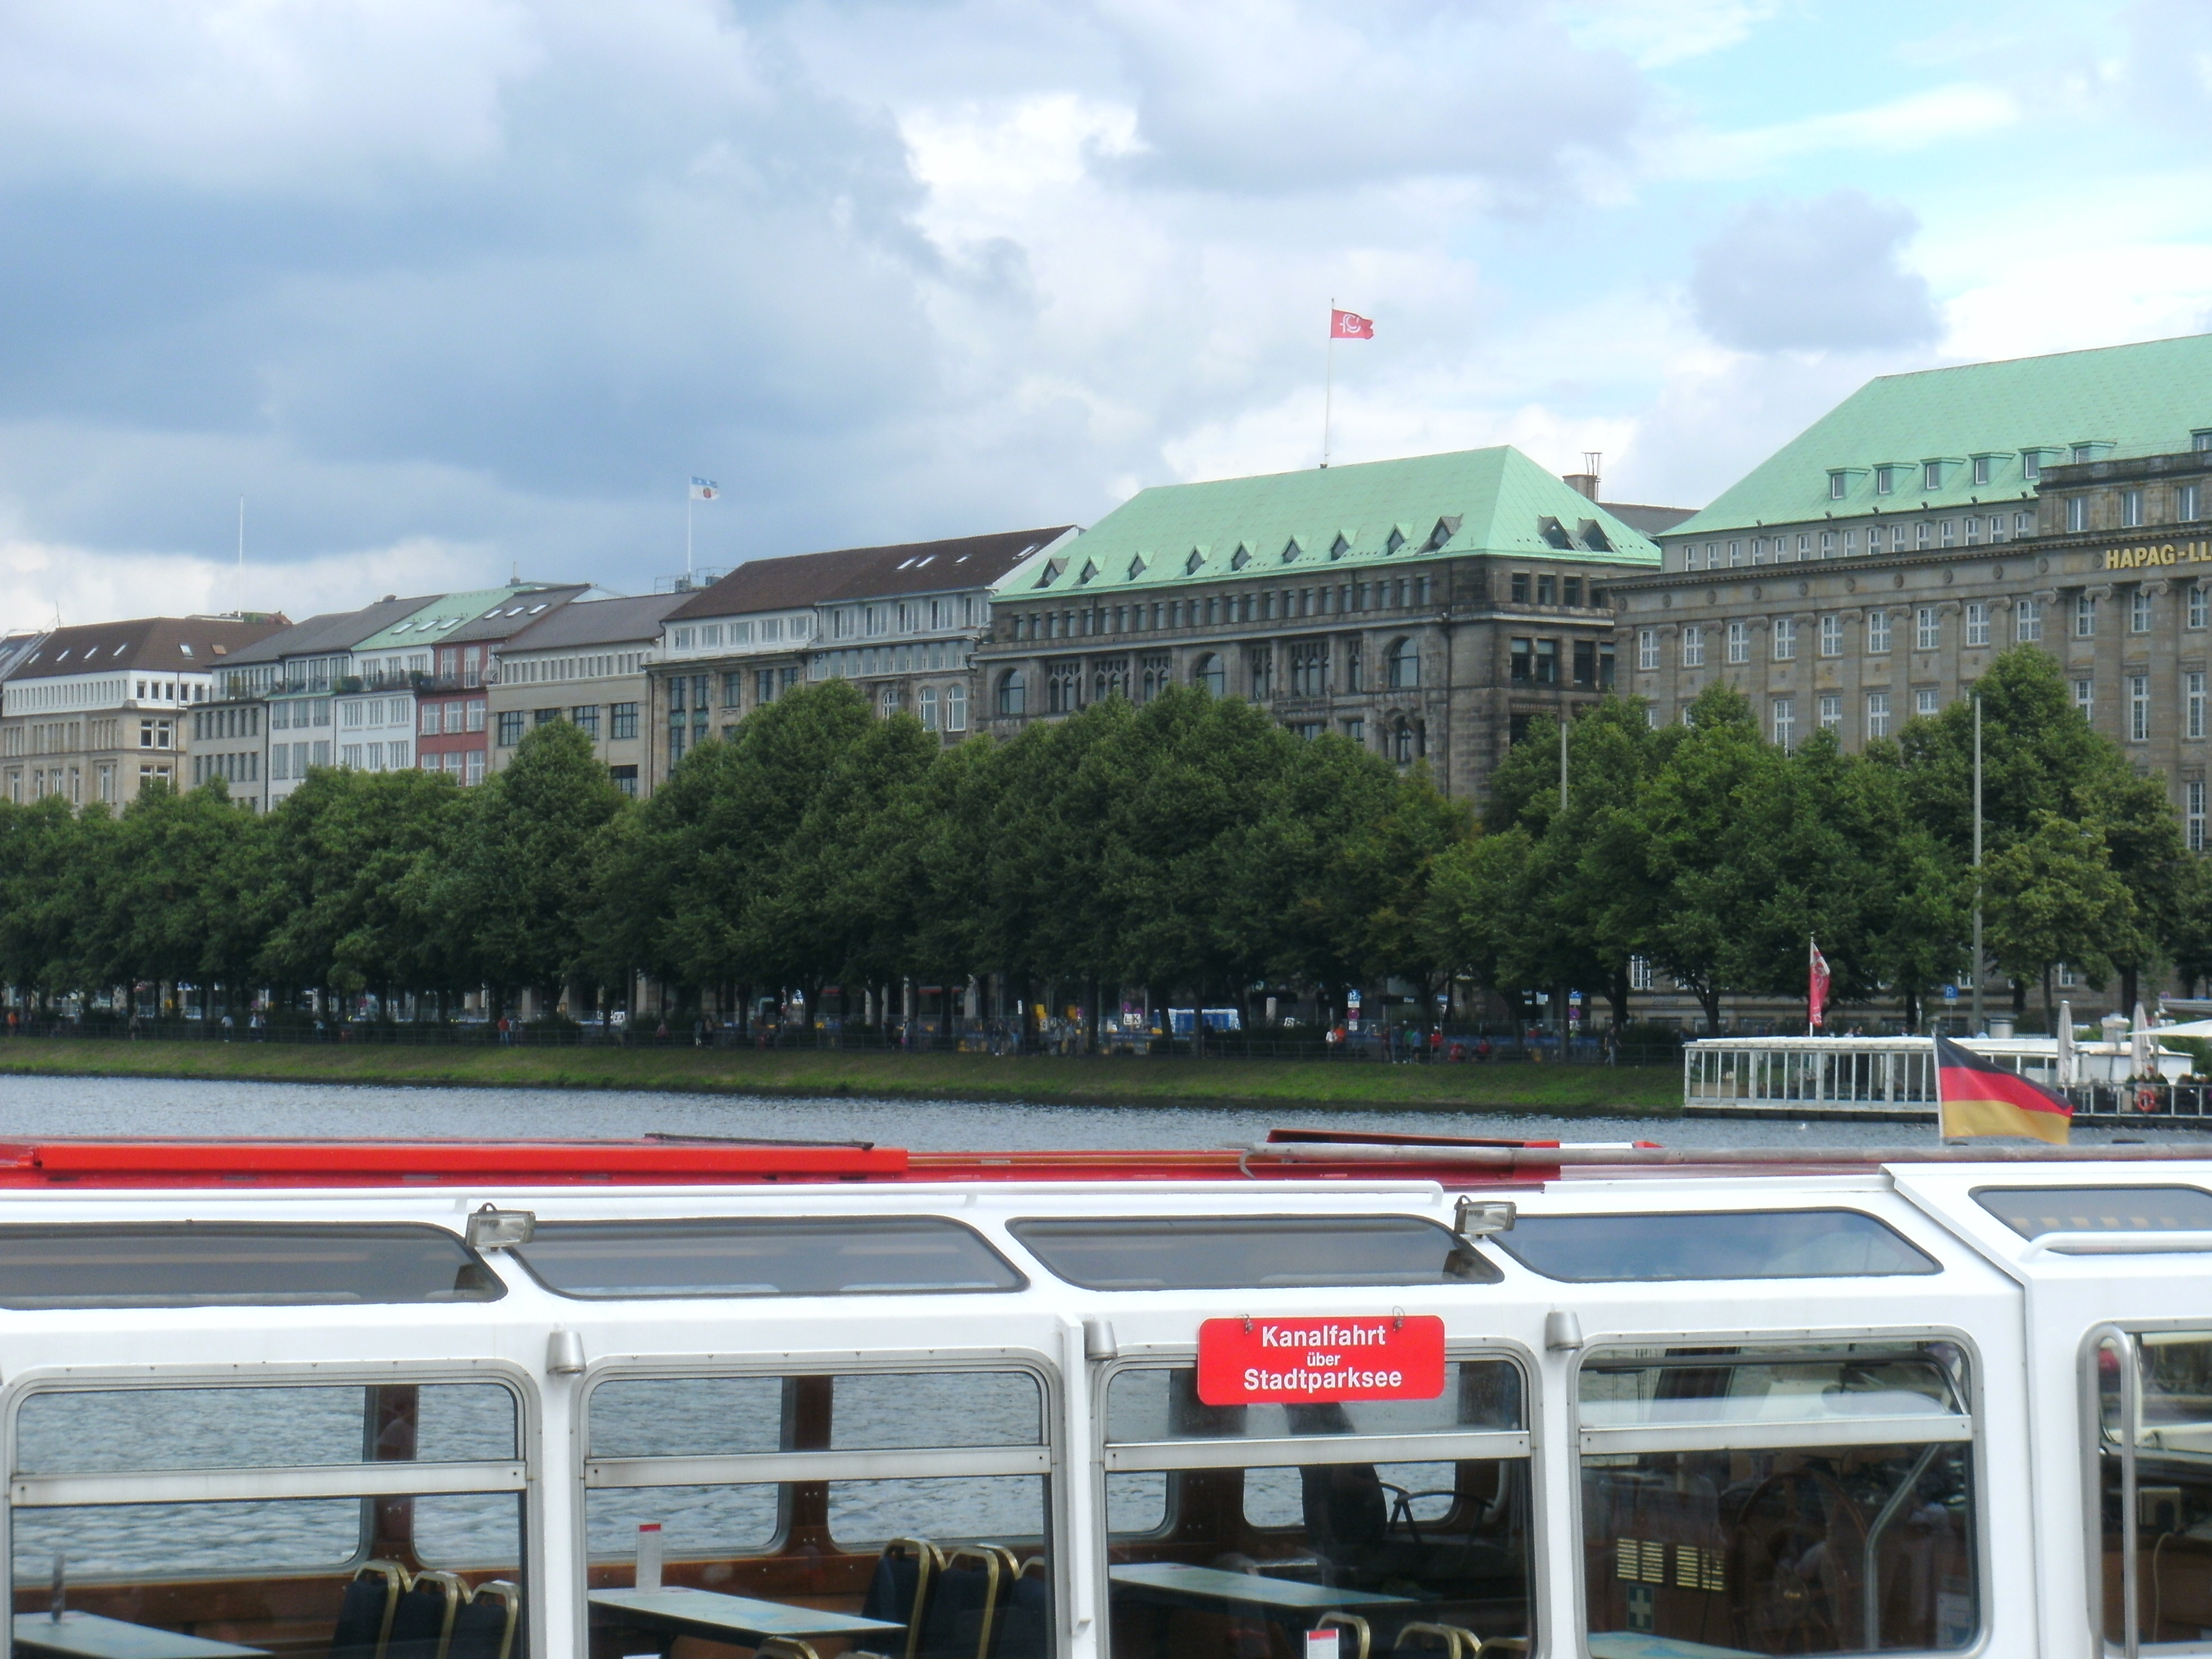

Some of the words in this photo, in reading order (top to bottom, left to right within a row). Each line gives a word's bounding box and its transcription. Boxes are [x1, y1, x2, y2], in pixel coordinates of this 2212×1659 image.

[1262, 1325, 1386, 1347] Kanalfahrt
[1307, 1352, 1341, 1367] über
[1243, 1366, 1403, 1394] Stadtparksee
